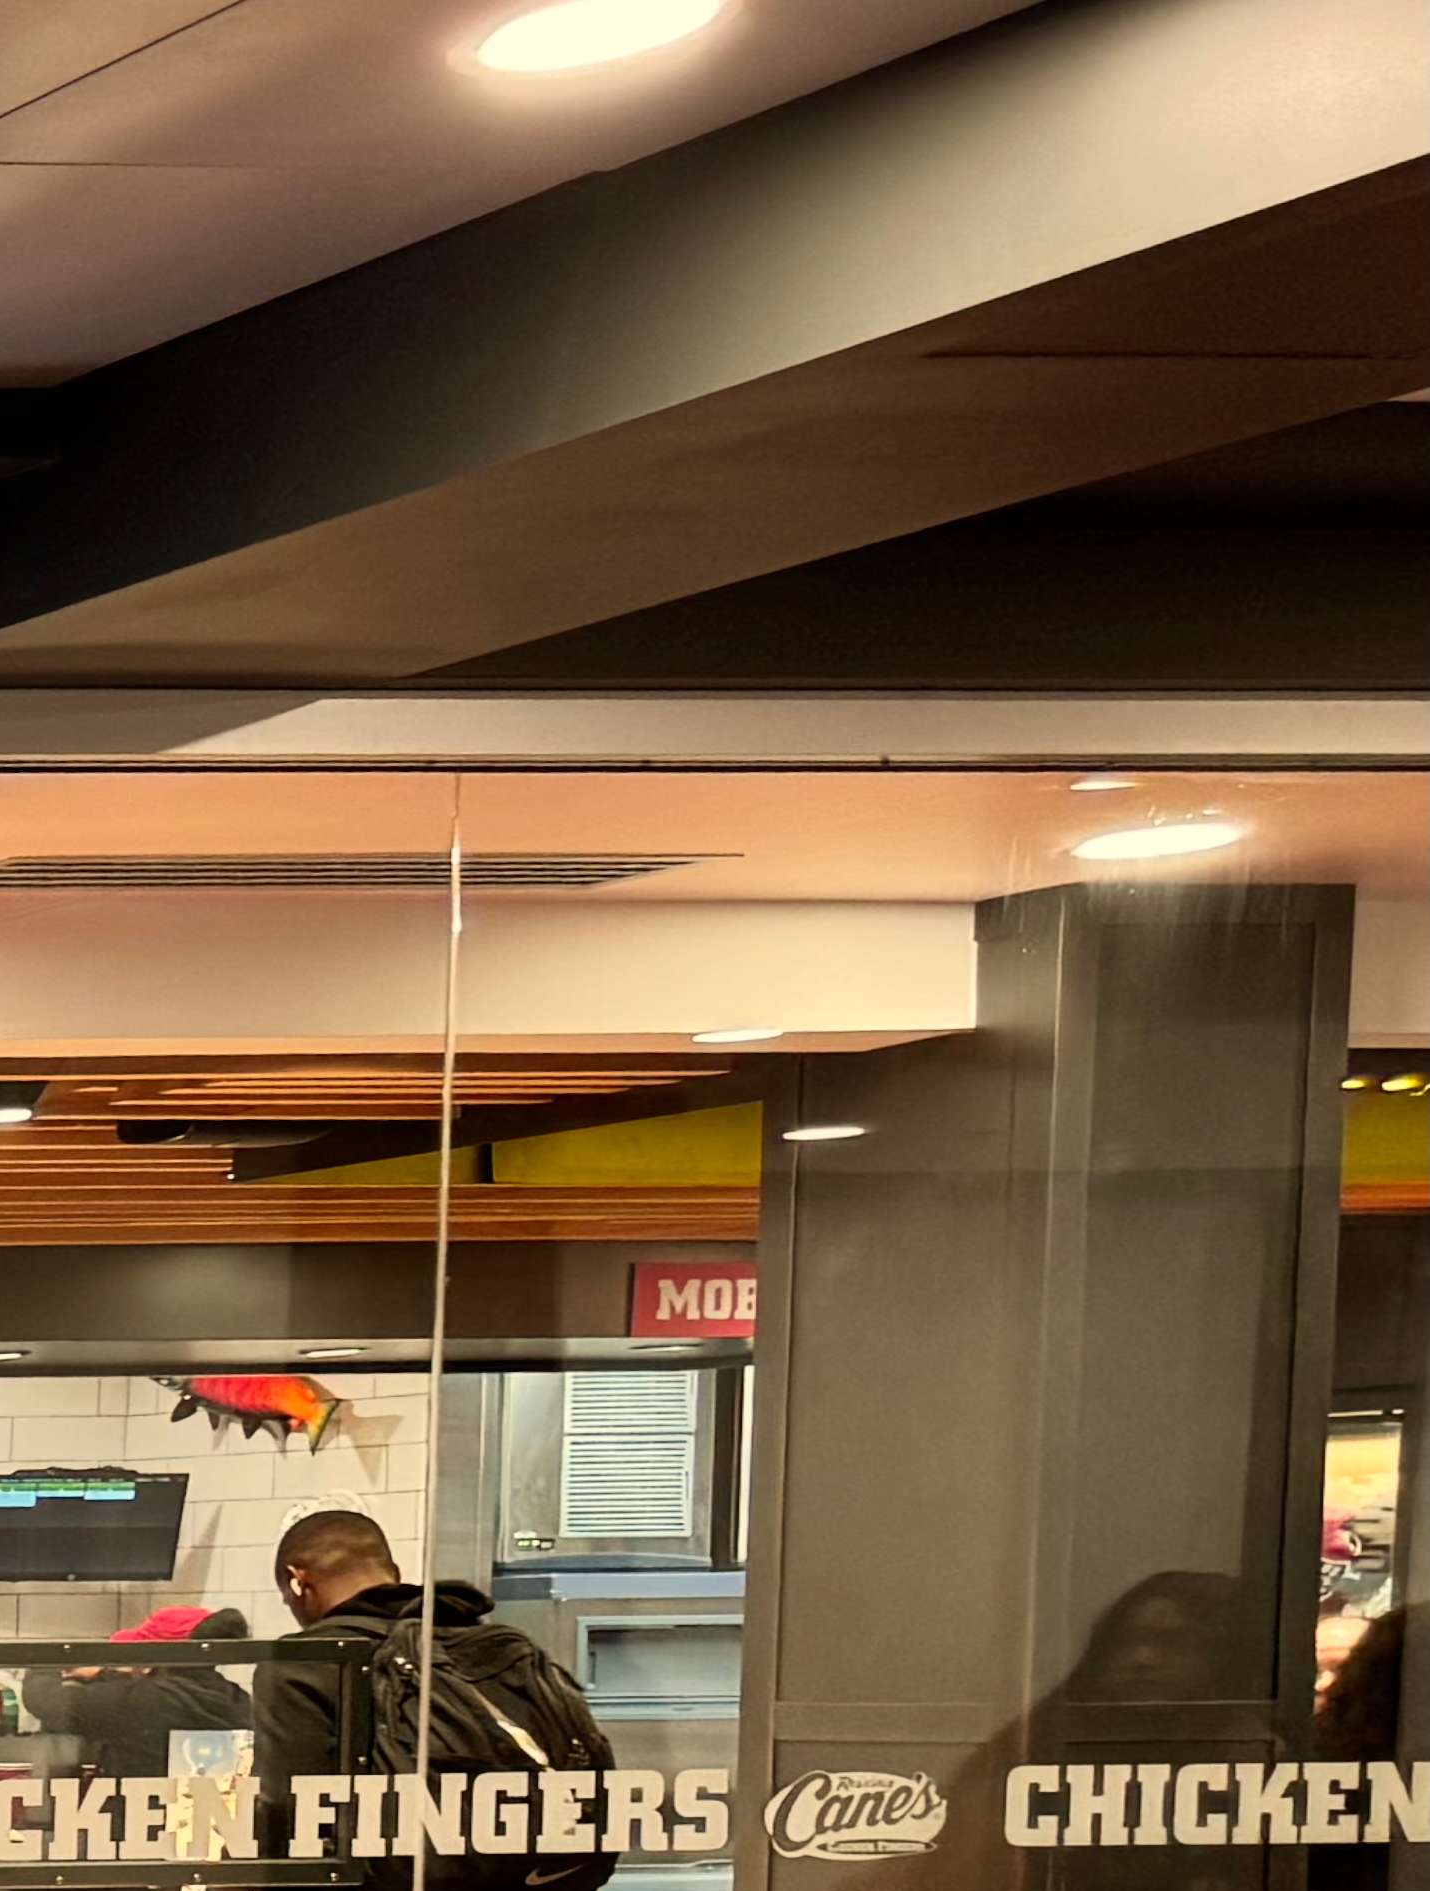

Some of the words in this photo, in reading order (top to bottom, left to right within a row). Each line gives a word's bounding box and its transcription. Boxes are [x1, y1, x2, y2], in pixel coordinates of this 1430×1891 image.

[655, 1278, 758, 1320] MOB
[288, 1768, 731, 1859] FINGERS
[773, 1772, 942, 1852] Cane's
[1004, 1761, 1430, 1847] CHICKEN
